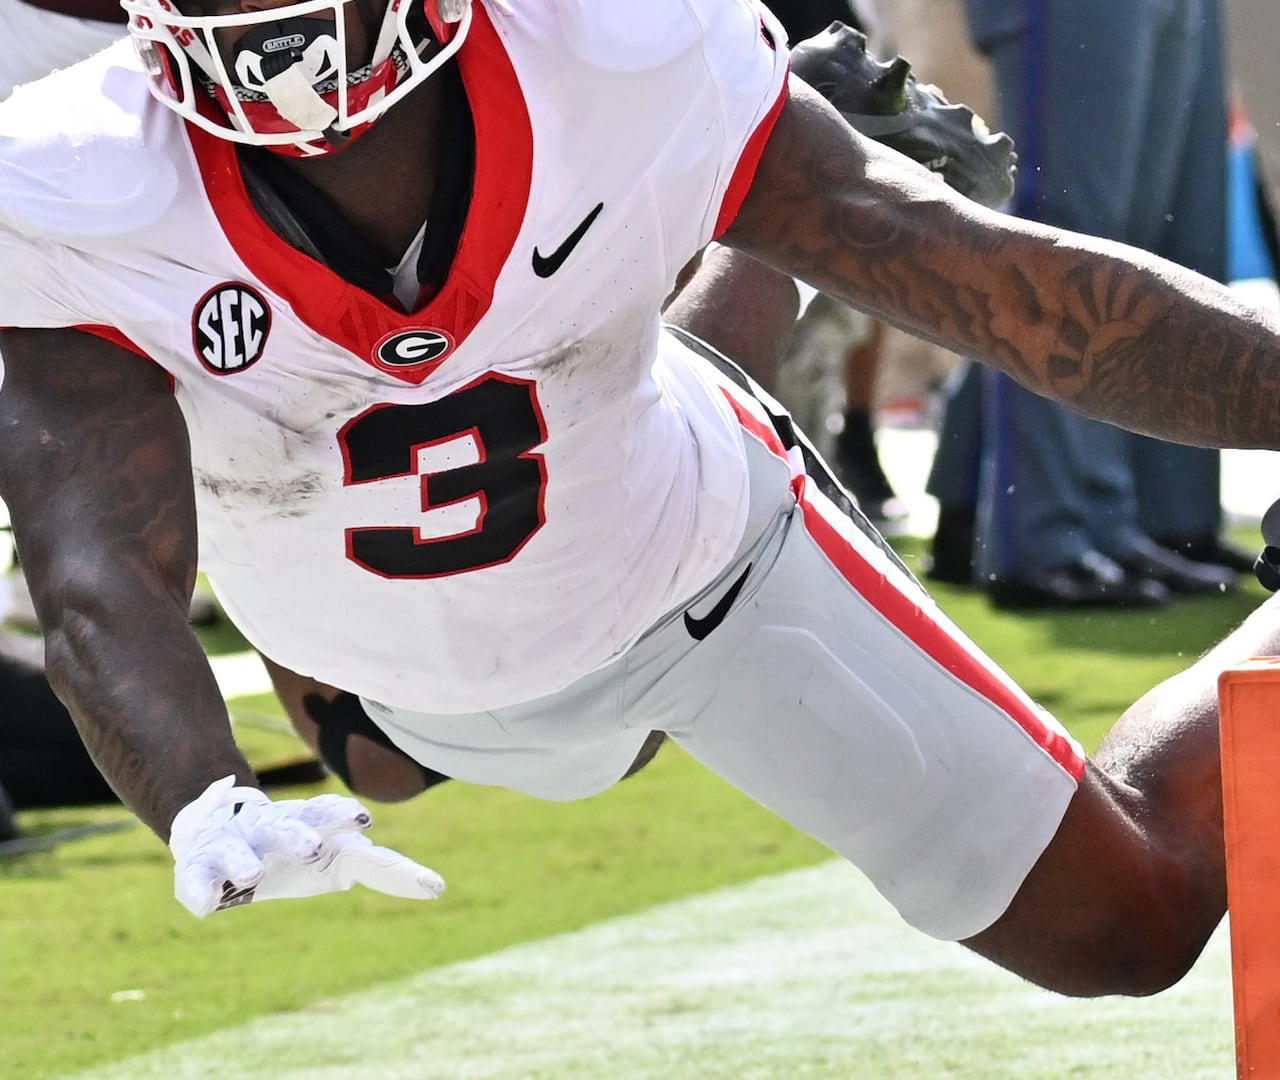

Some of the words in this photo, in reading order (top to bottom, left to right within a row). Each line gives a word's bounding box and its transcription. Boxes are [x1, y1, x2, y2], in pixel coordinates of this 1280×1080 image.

[266, 36, 302, 50] BATTLE
[198, 288, 265, 370] SEC
[391, 333, 449, 361] G
[336, 370, 549, 580] 3
